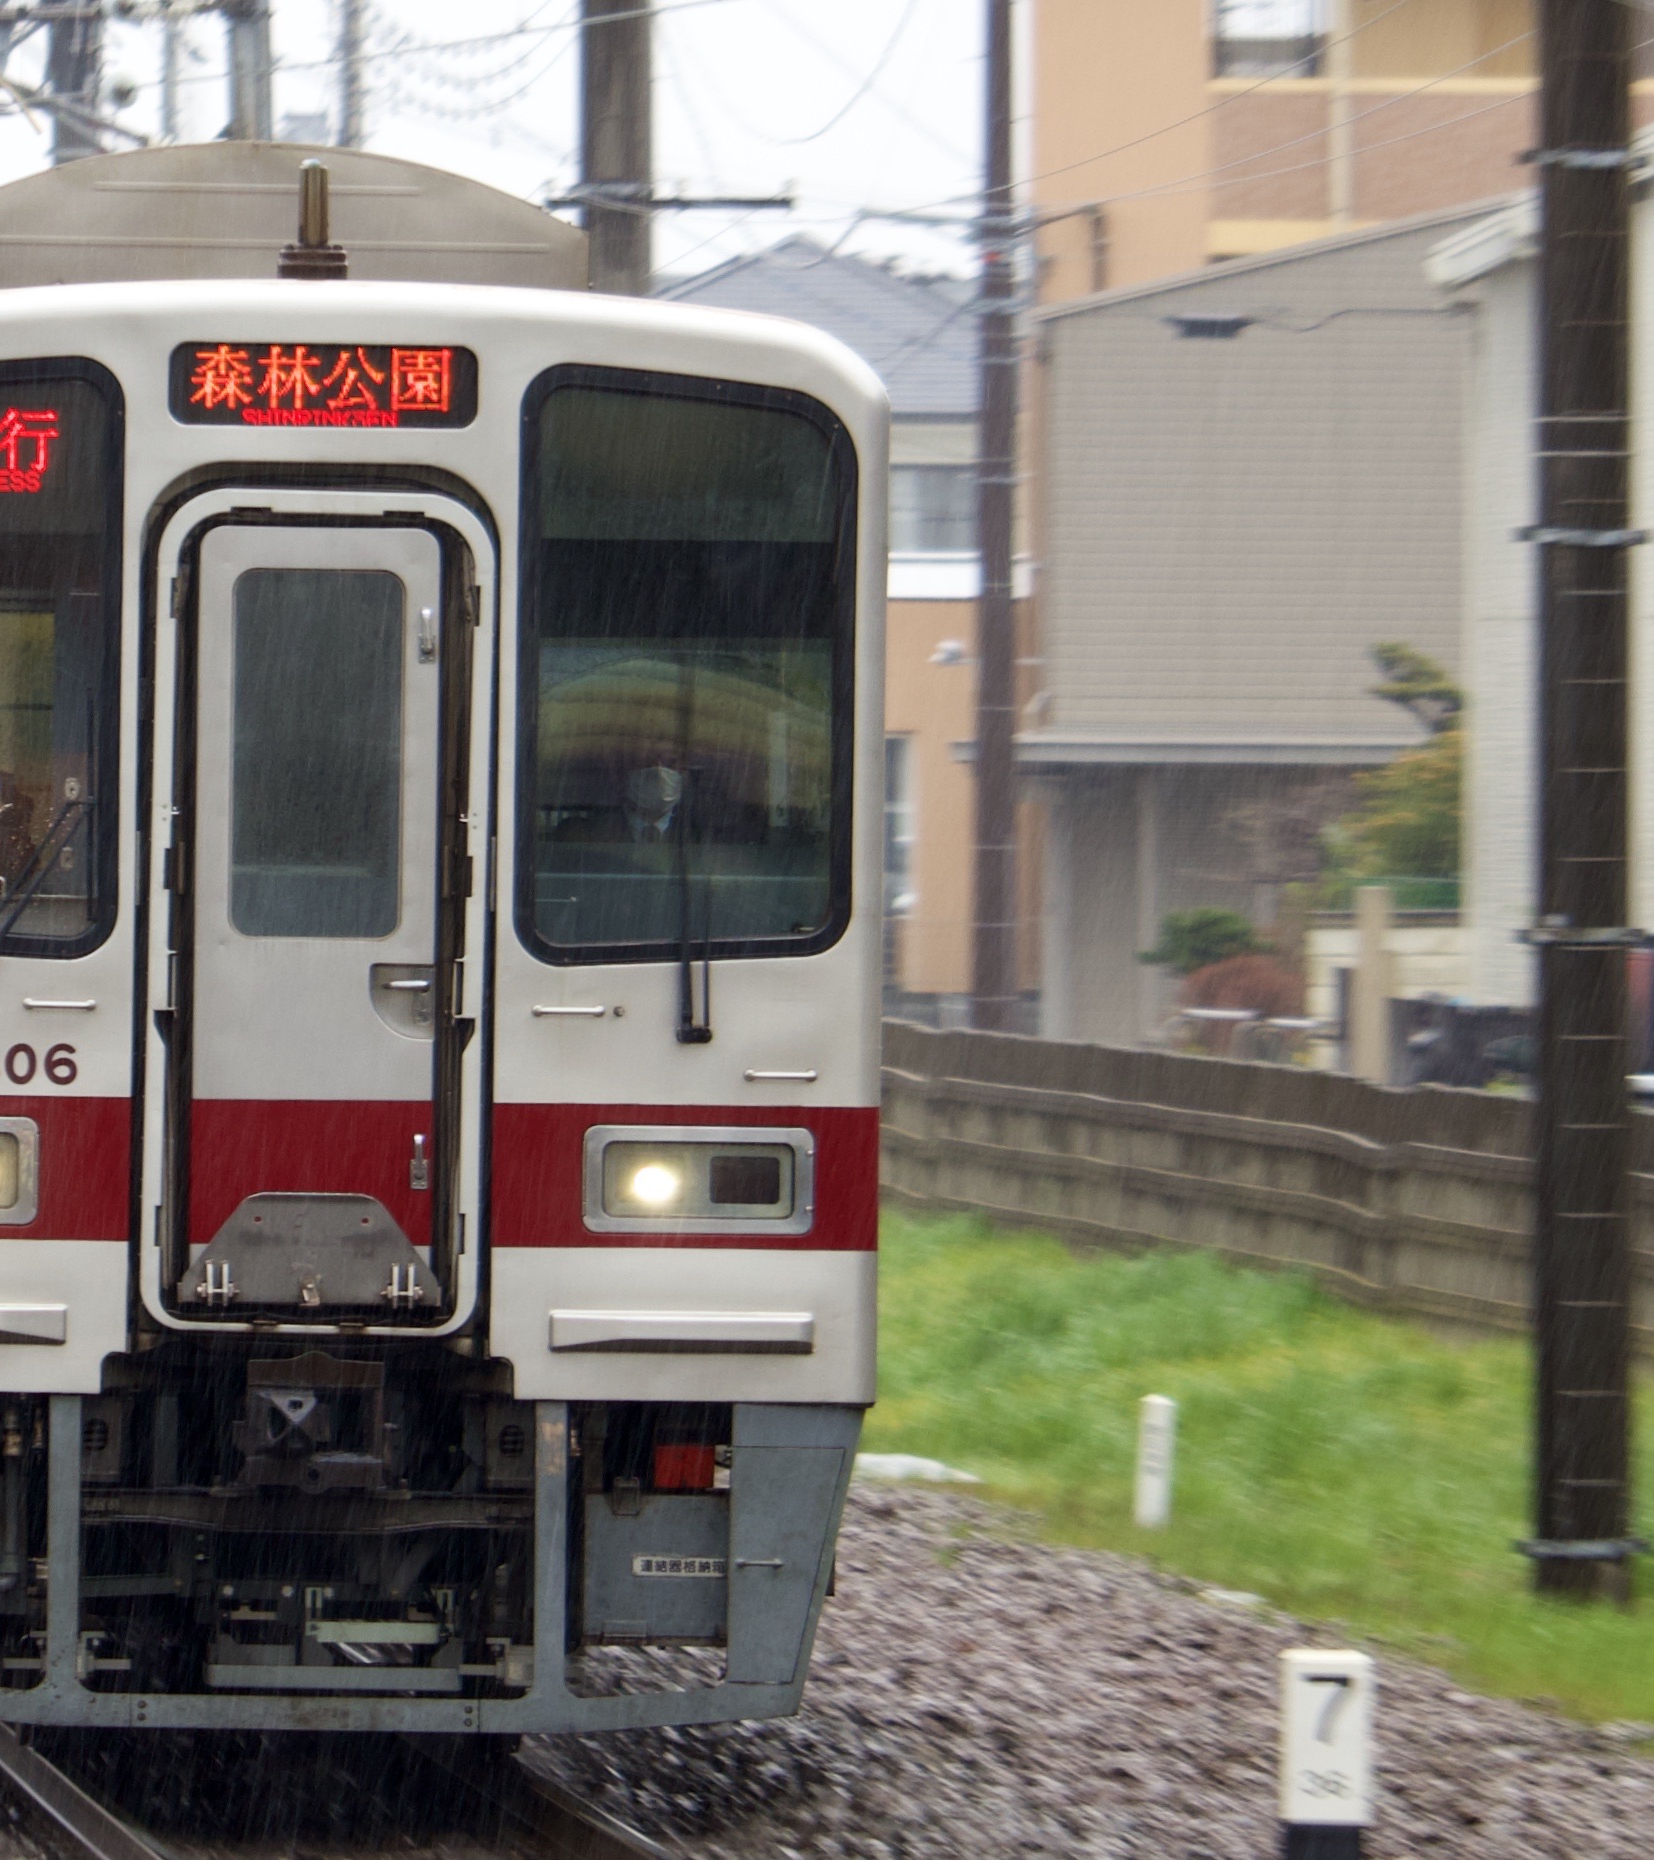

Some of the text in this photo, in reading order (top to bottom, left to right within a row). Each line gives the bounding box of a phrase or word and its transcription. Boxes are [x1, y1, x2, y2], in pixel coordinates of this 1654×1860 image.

[190, 344, 453, 412] 森林公園
[1299, 1672, 1356, 1746] 7
